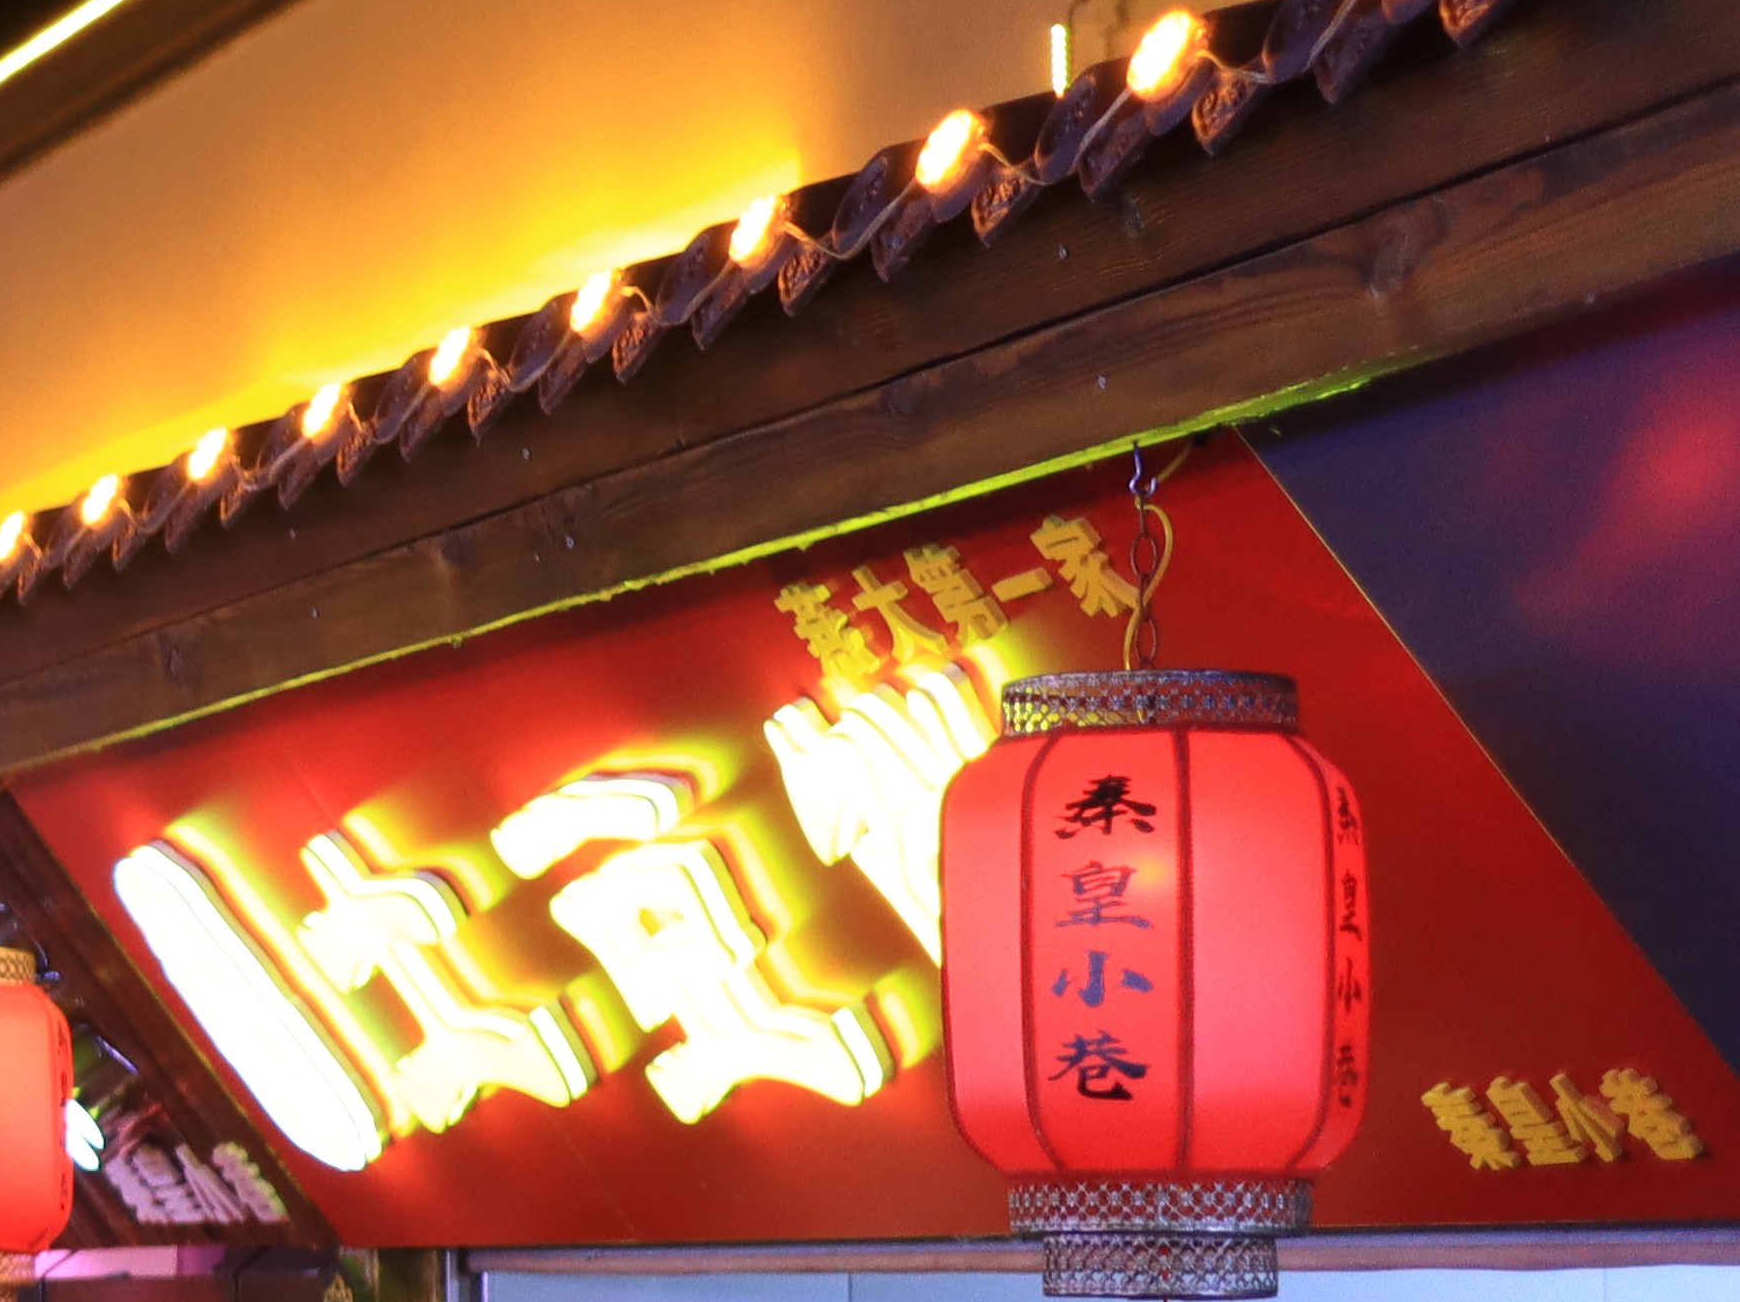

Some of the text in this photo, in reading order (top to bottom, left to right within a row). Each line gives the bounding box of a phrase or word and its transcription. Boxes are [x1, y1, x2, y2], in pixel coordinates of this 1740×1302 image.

[774, 513, 1141, 681] 燕大第一家
[1048, 774, 1156, 1101] 秦皇小巷
[1421, 1067, 1703, 1171] 秦皇小巷
